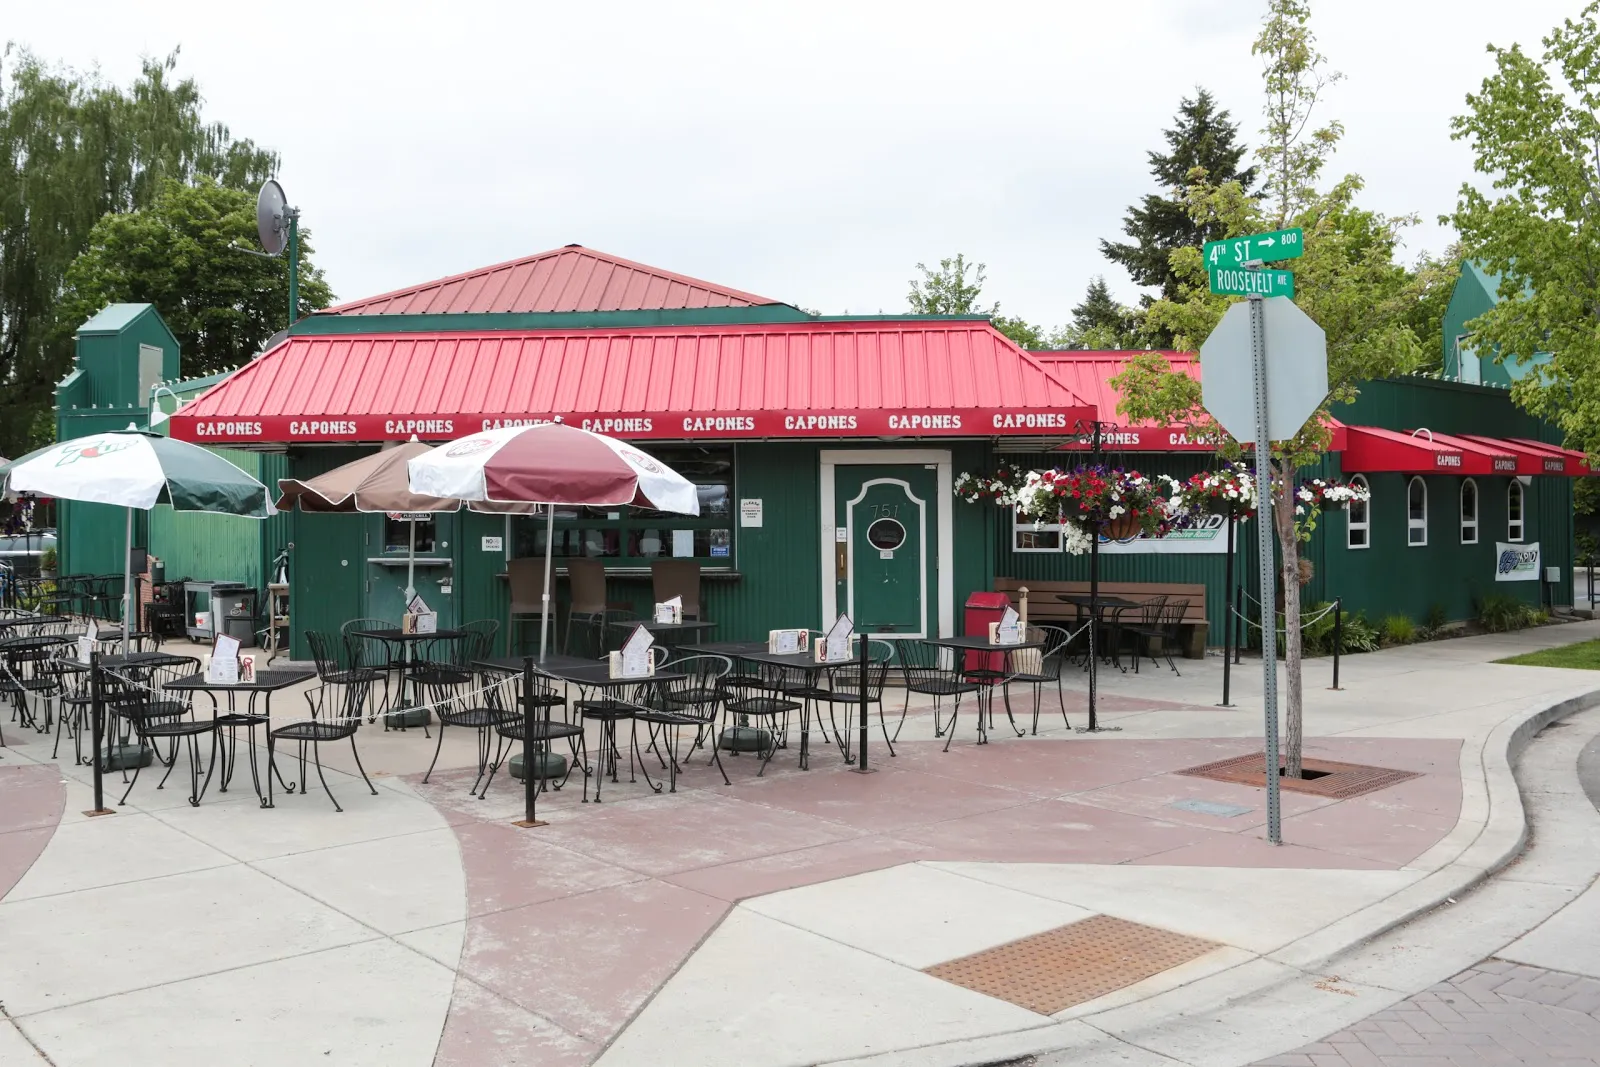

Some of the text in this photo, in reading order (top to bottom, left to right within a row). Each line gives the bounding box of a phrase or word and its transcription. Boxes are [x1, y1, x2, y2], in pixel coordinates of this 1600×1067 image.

[1209, 233, 1296, 265] 4TH ST 800
[1216, 269, 1288, 294] ROOSEVELT AVE
[289, 421, 357, 435] CAPONES
[385, 419, 454, 434] CAPONES
[482, 418, 551, 432] CAPO
[581, 418, 653, 433] CAPONES
[683, 416, 755, 431] CAPONES
[784, 415, 858, 430] CAPONES
[888, 414, 962, 429] CAPONES
[993, 413, 1067, 428] CAPONES
[196, 422, 263, 436] CAPONES
[1079, 432, 1140, 445] PONES
[1169, 432, 1229, 445] CAON
[1437, 455, 1461, 467] CAPONES
[1494, 460, 1515, 471] CAPONES
[1544, 462, 1564, 471] CAPONES
[870, 504, 899, 519] 751
